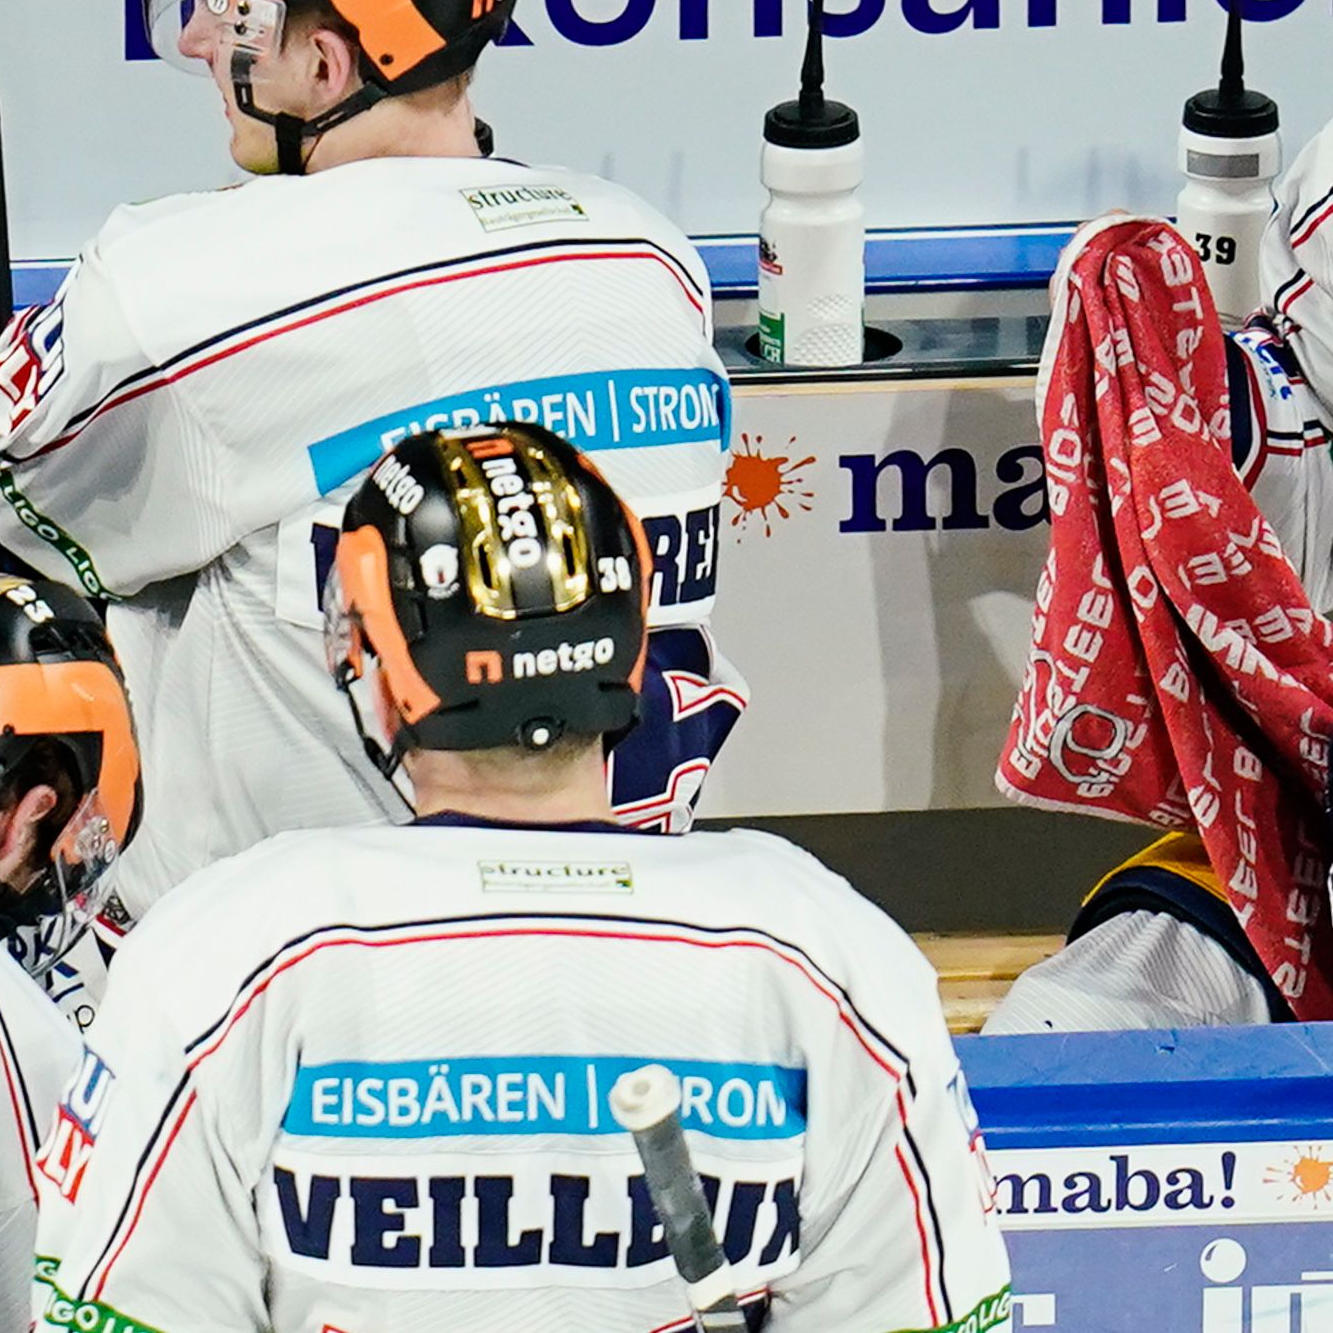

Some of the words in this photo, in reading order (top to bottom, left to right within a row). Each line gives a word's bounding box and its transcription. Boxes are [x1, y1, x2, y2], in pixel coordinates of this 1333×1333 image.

[1194, 233, 1236, 264] 39
[482, 458, 542, 569] netgo
[513, 637, 614, 678] netgo
[311, 1066, 567, 1127] EISBÄREN
[995, 1150, 1237, 1215] maba!
